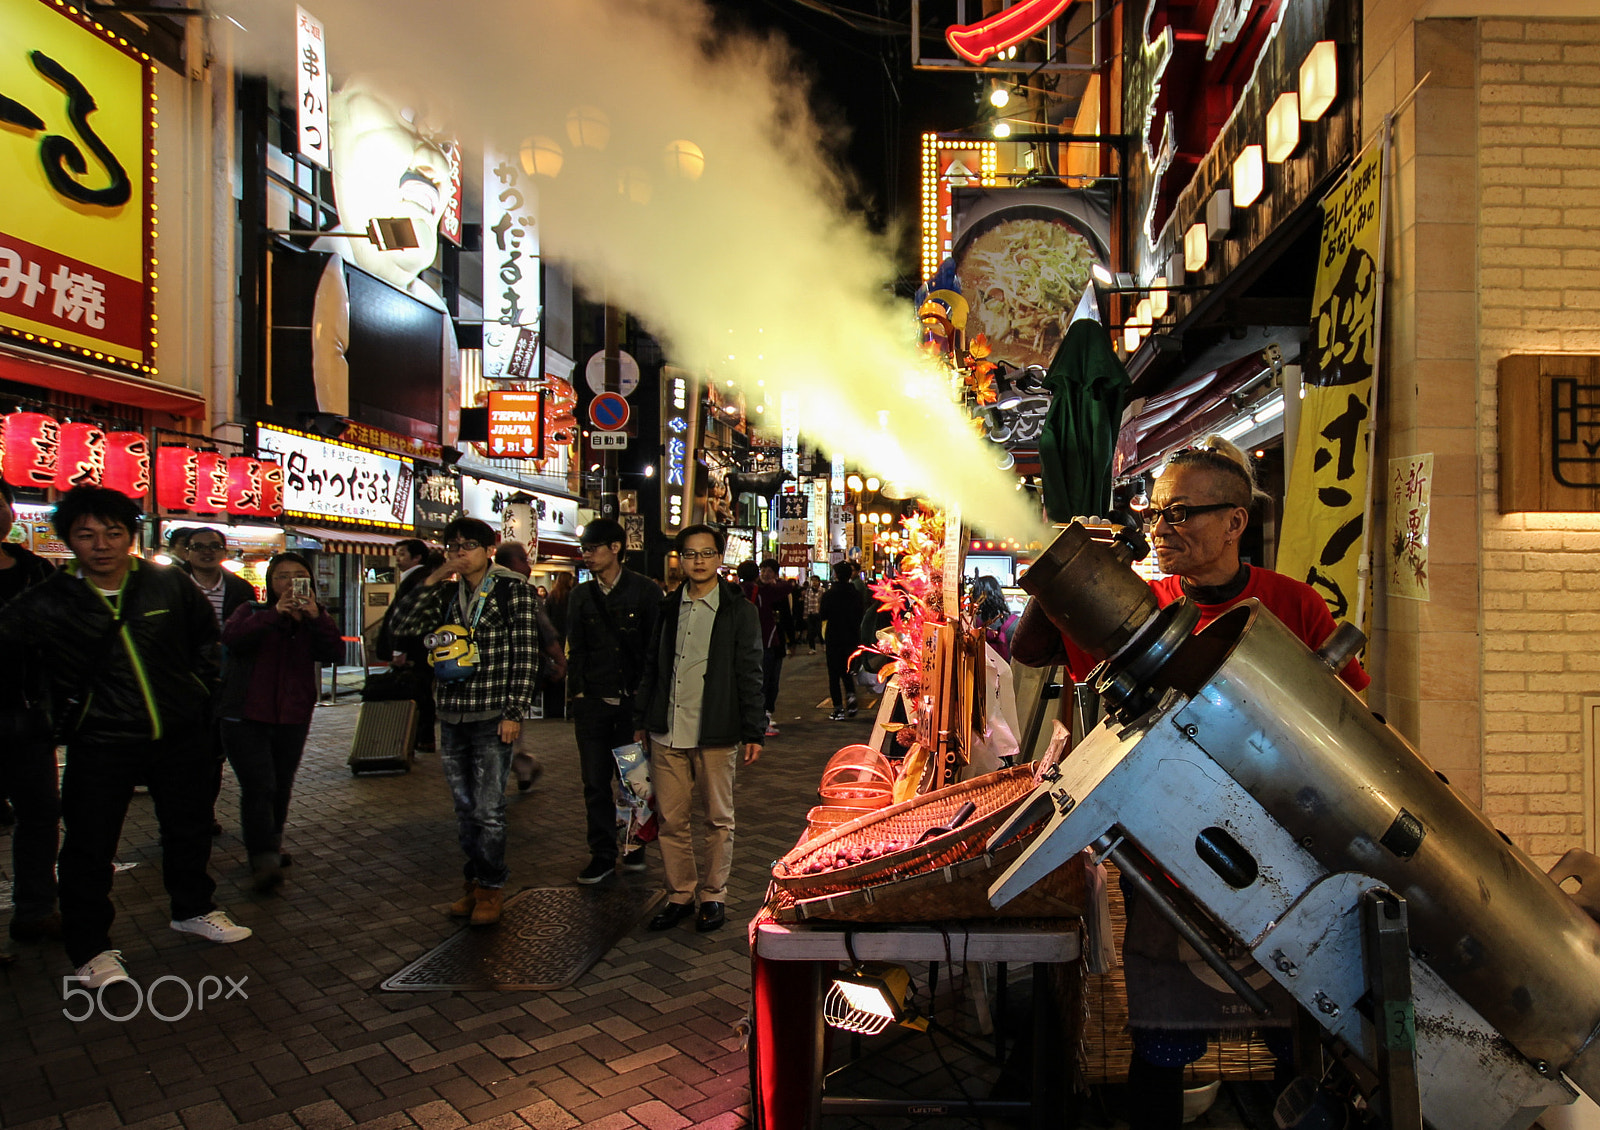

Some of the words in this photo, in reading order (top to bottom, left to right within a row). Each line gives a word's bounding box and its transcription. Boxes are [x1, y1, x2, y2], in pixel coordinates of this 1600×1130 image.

[299, 16, 322, 42] 元祖
[301, 44, 324, 150] 串かつ
[1322, 161, 1378, 243] テレビ放映で
[1325, 200, 1375, 267] おなじみの
[490, 424, 532, 435] JINJYA
[491, 411, 537, 422] TEPPAN
[507, 441, 520, 452] B1
[592, 435, 625, 446] 自動車
[288, 448, 391, 506] 串かつだるま
